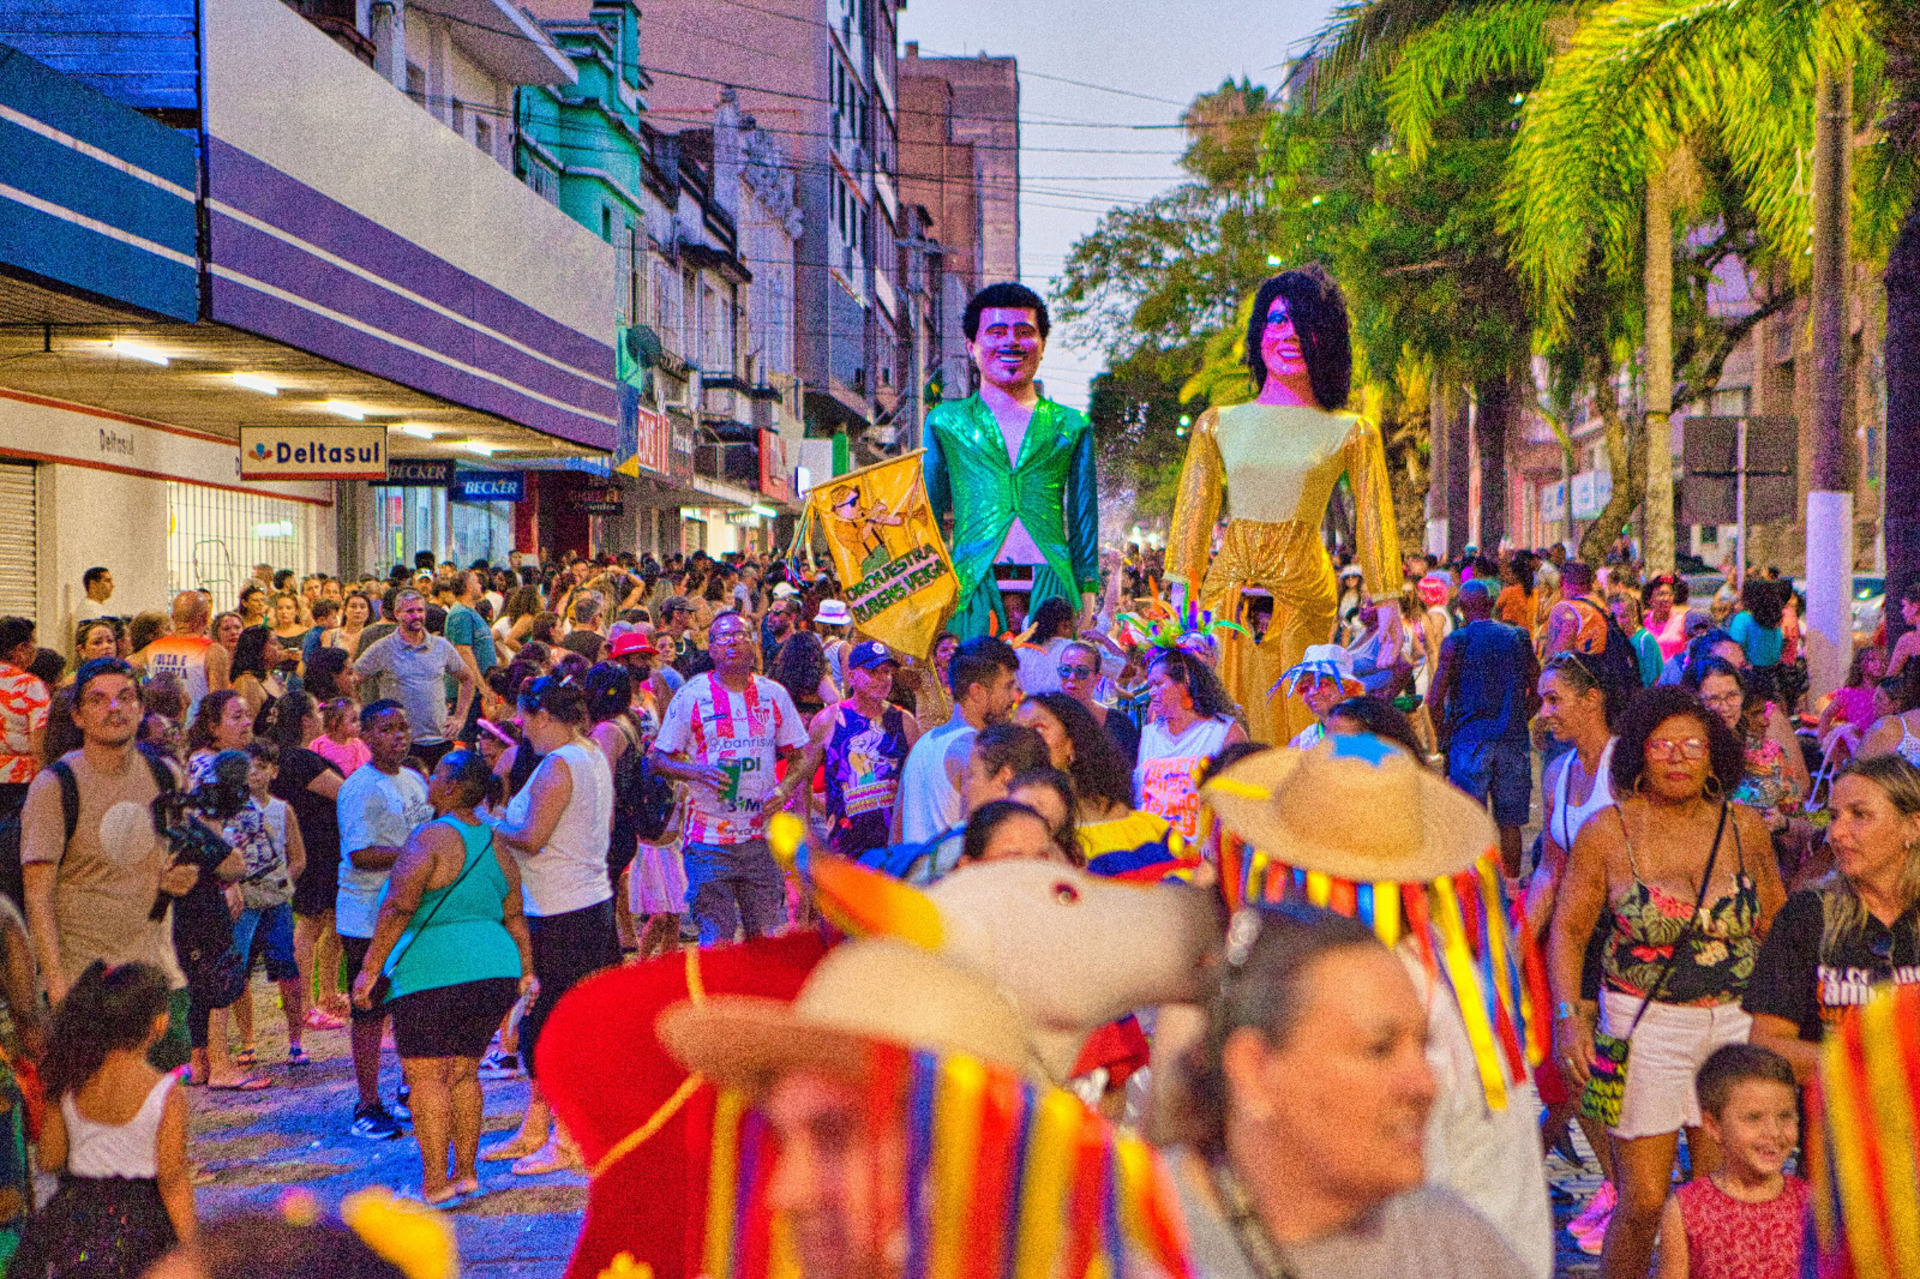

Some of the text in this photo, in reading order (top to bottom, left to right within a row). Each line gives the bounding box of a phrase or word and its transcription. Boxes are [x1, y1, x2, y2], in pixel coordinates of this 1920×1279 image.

[276, 441, 379, 463] Deltasul
[389, 464, 447, 480] BECKER
[464, 480, 518, 494] BECKER
[845, 543, 939, 601] ORQUESTRA
